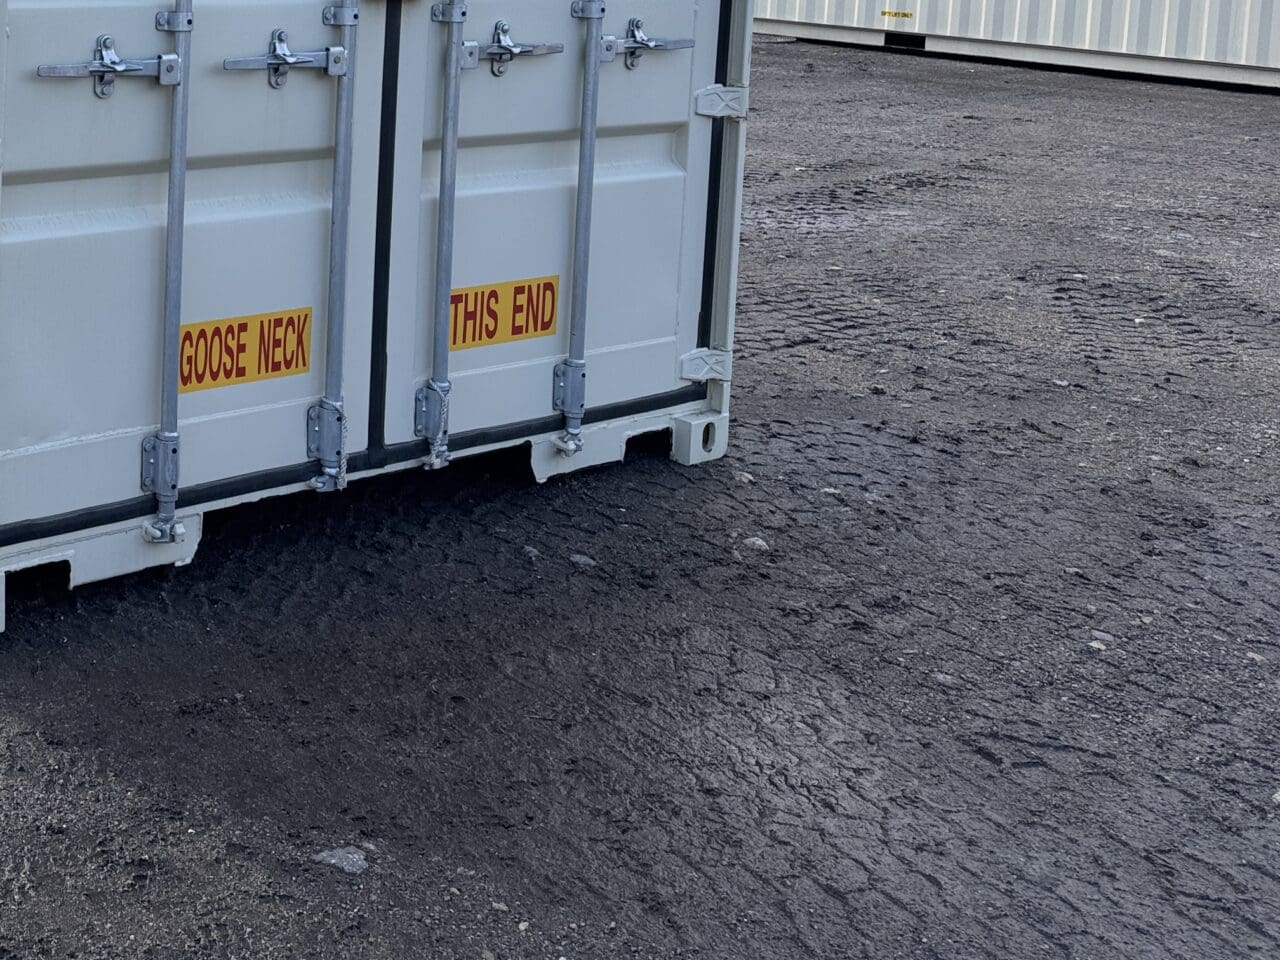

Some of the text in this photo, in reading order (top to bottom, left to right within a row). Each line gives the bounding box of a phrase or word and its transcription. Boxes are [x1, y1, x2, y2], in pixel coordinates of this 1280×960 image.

[450, 282, 556, 346] THIS END
[179, 313, 308, 387] GOOSE NECK
